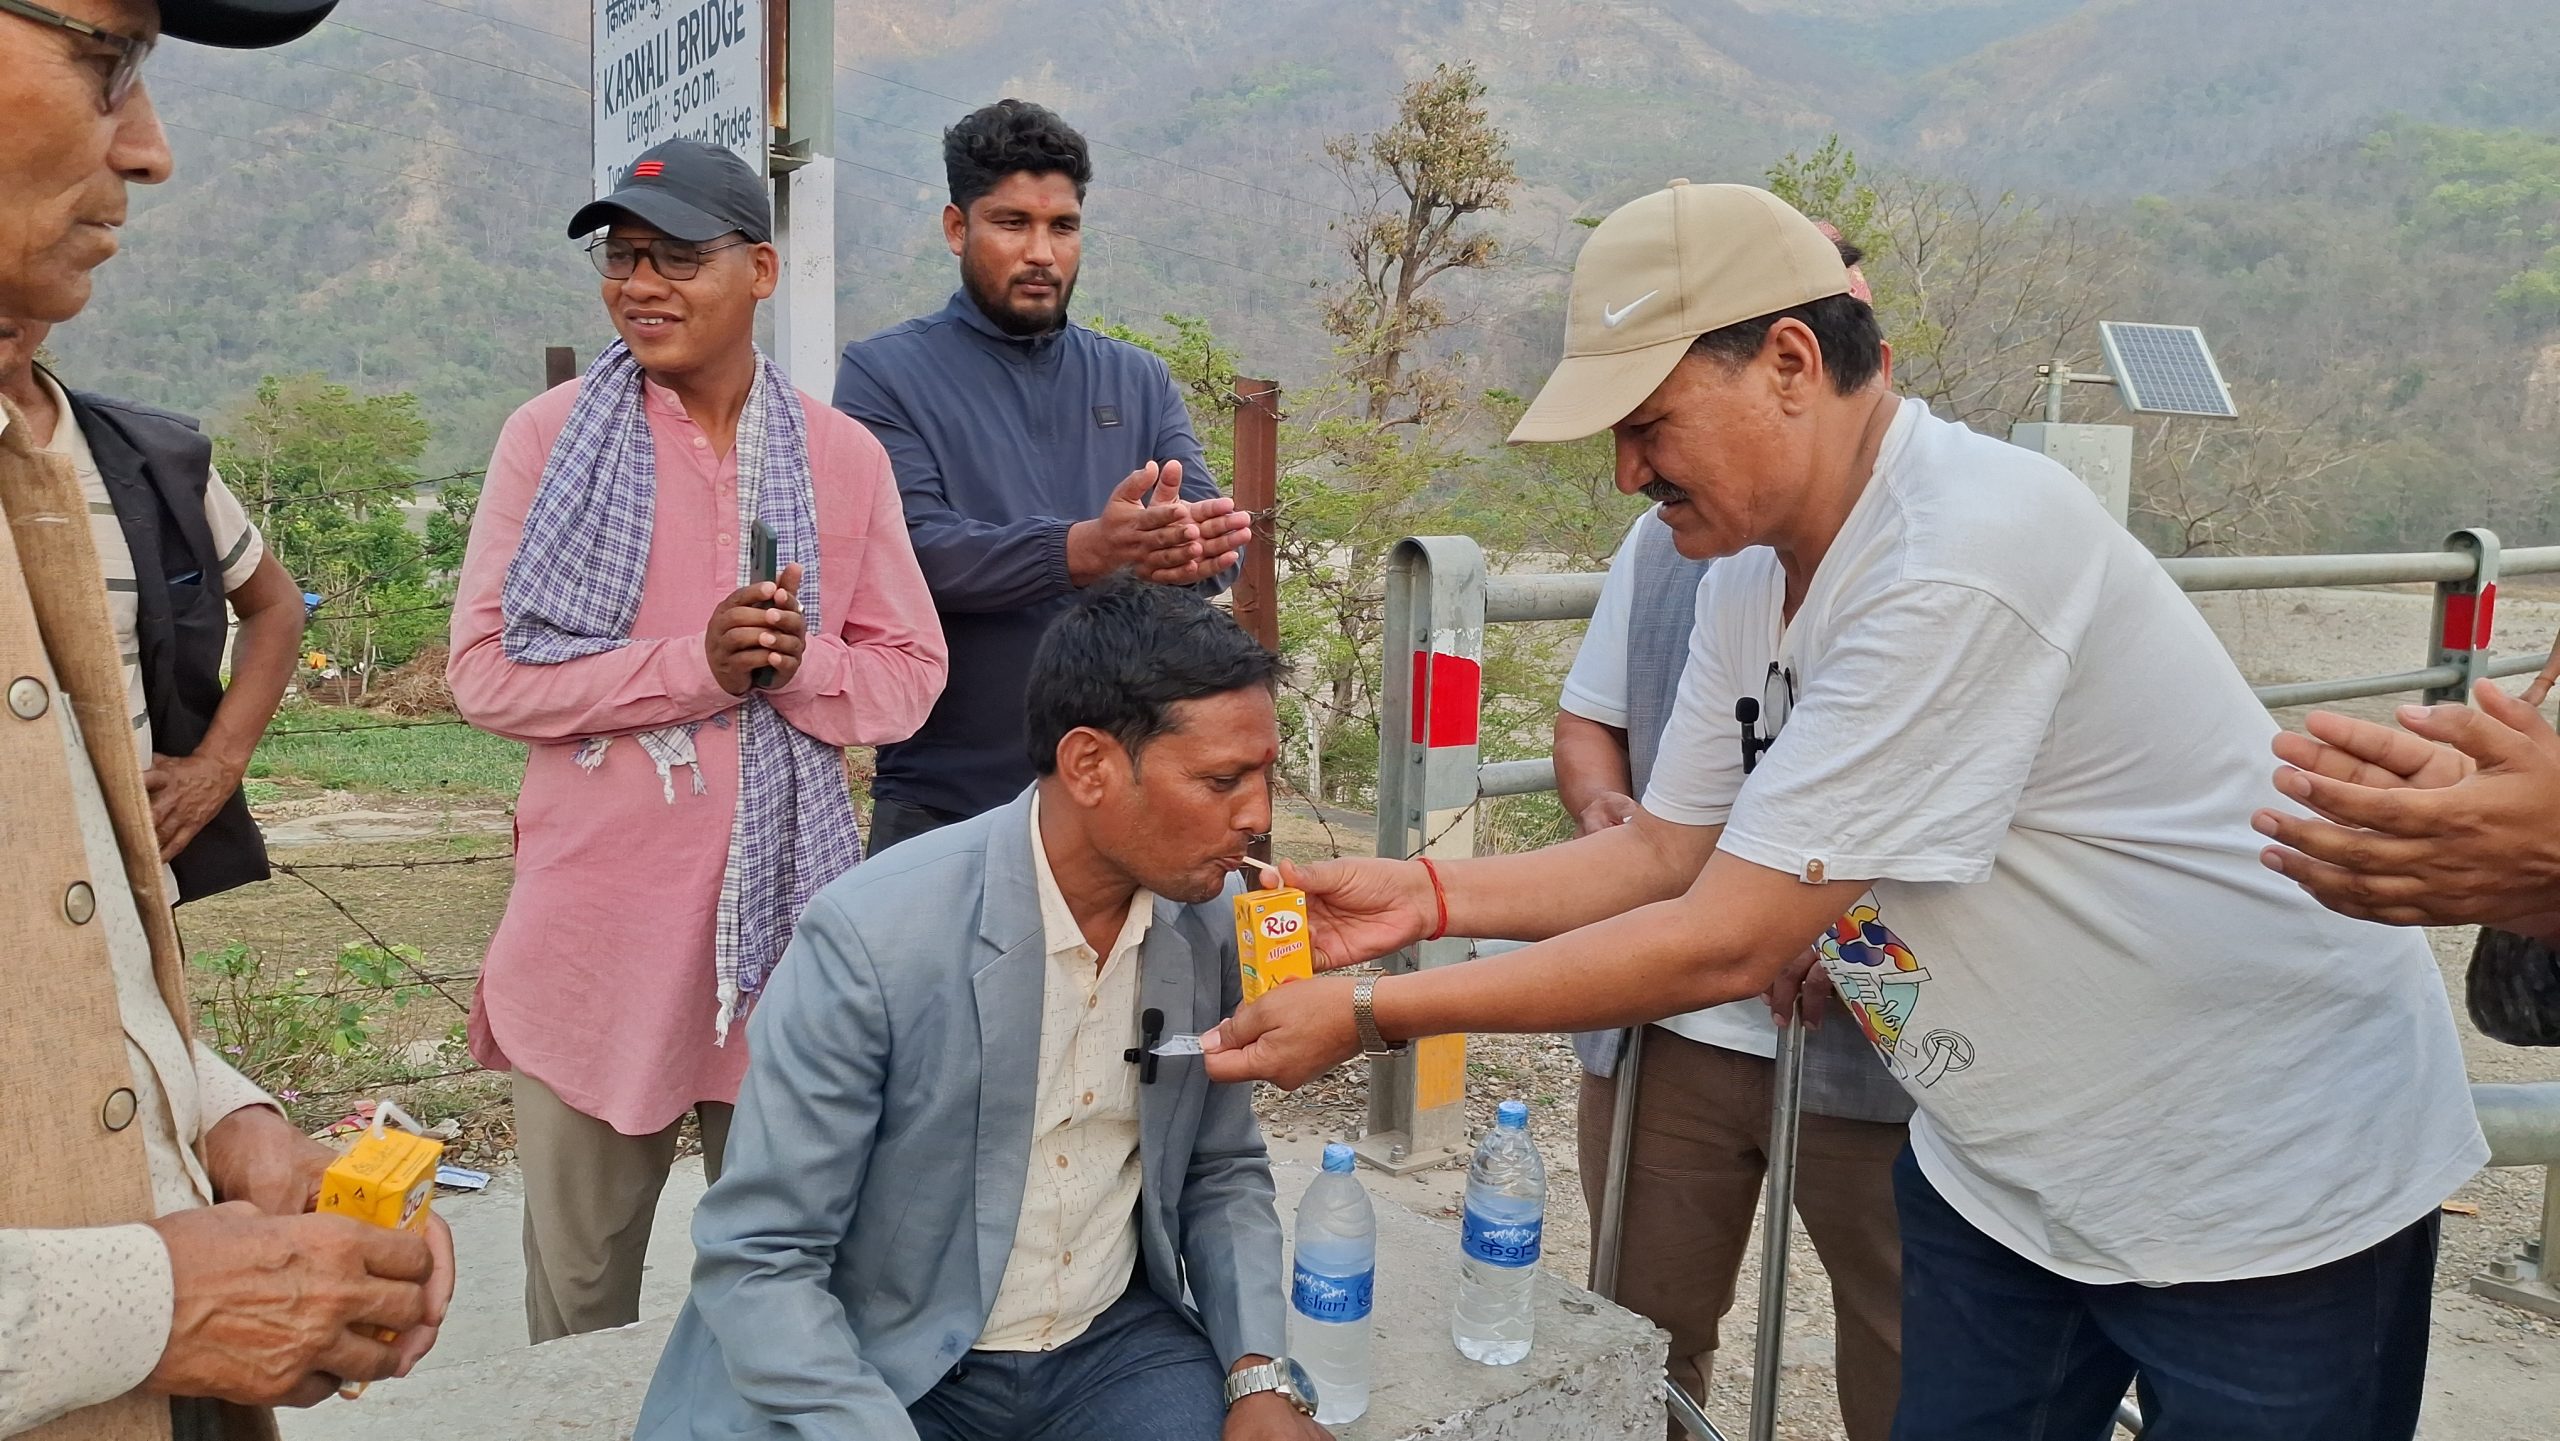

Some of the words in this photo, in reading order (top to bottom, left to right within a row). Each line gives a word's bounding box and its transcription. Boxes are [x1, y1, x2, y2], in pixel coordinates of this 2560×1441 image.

[604, 28, 669, 120] KARNALI
[677, 0, 746, 76] BRIDGE
[626, 94, 661, 147] Length
[713, 105, 752, 153] Bridge
[1264, 916, 1298, 936] Rio
